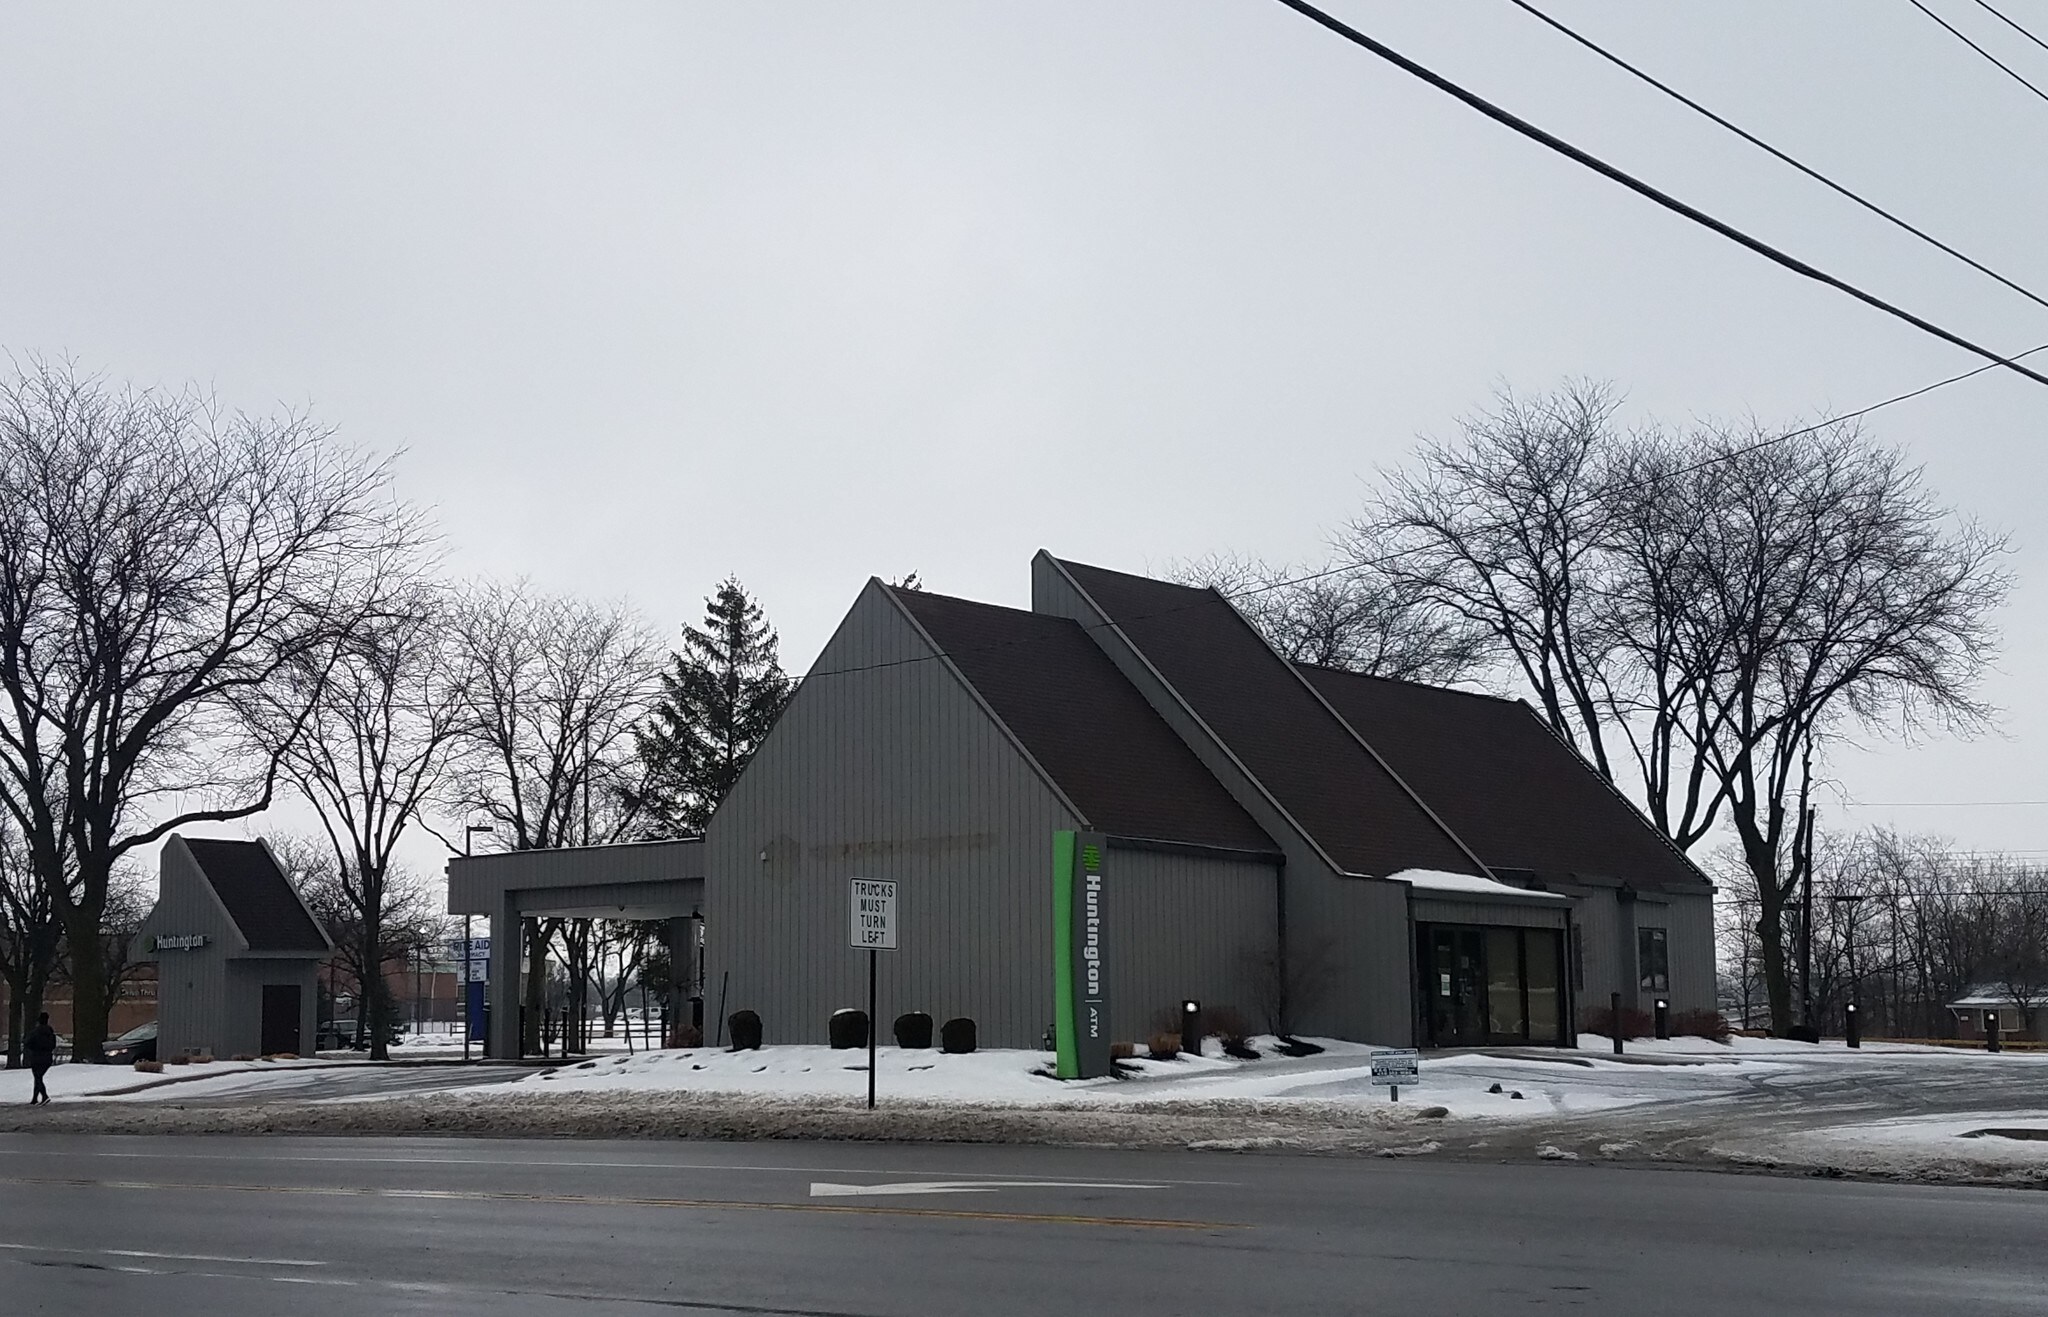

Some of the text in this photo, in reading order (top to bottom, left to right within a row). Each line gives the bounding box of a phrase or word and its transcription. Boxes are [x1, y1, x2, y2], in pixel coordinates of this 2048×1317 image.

[855, 882, 893, 898] TRUCKS
[860, 899, 887, 913] MUST
[860, 915, 886, 929] TURN
[156, 935, 203, 951] Huntington
[862, 930, 885, 944] LEFT
[474, 940, 490, 950] AID
[1083, 875, 1101, 1038] Huntington ATM
[140, 988, 155, 996] Thru
